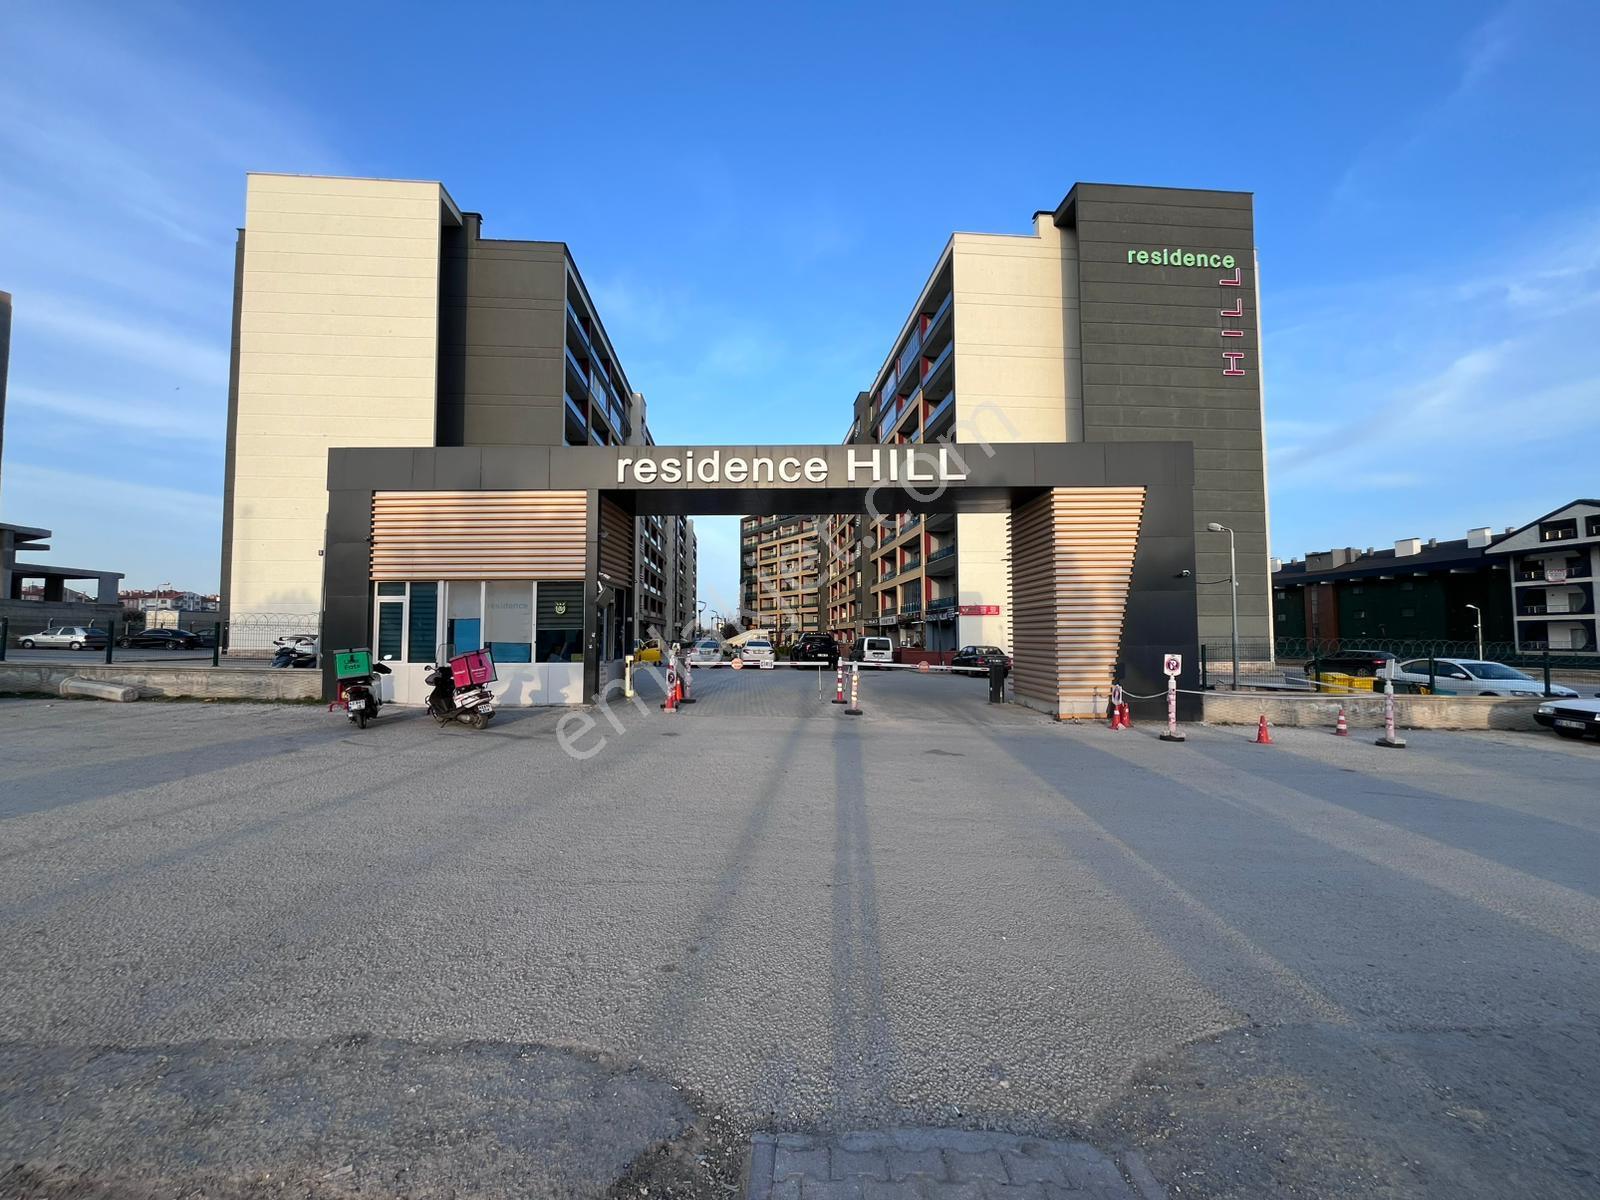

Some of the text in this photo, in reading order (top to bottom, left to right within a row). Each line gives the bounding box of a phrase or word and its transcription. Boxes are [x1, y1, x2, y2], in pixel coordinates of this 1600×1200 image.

[1128, 248, 1235, 269] residence
[1219, 267, 1246, 376] HILL
[617, 448, 967, 484] residence HILL
